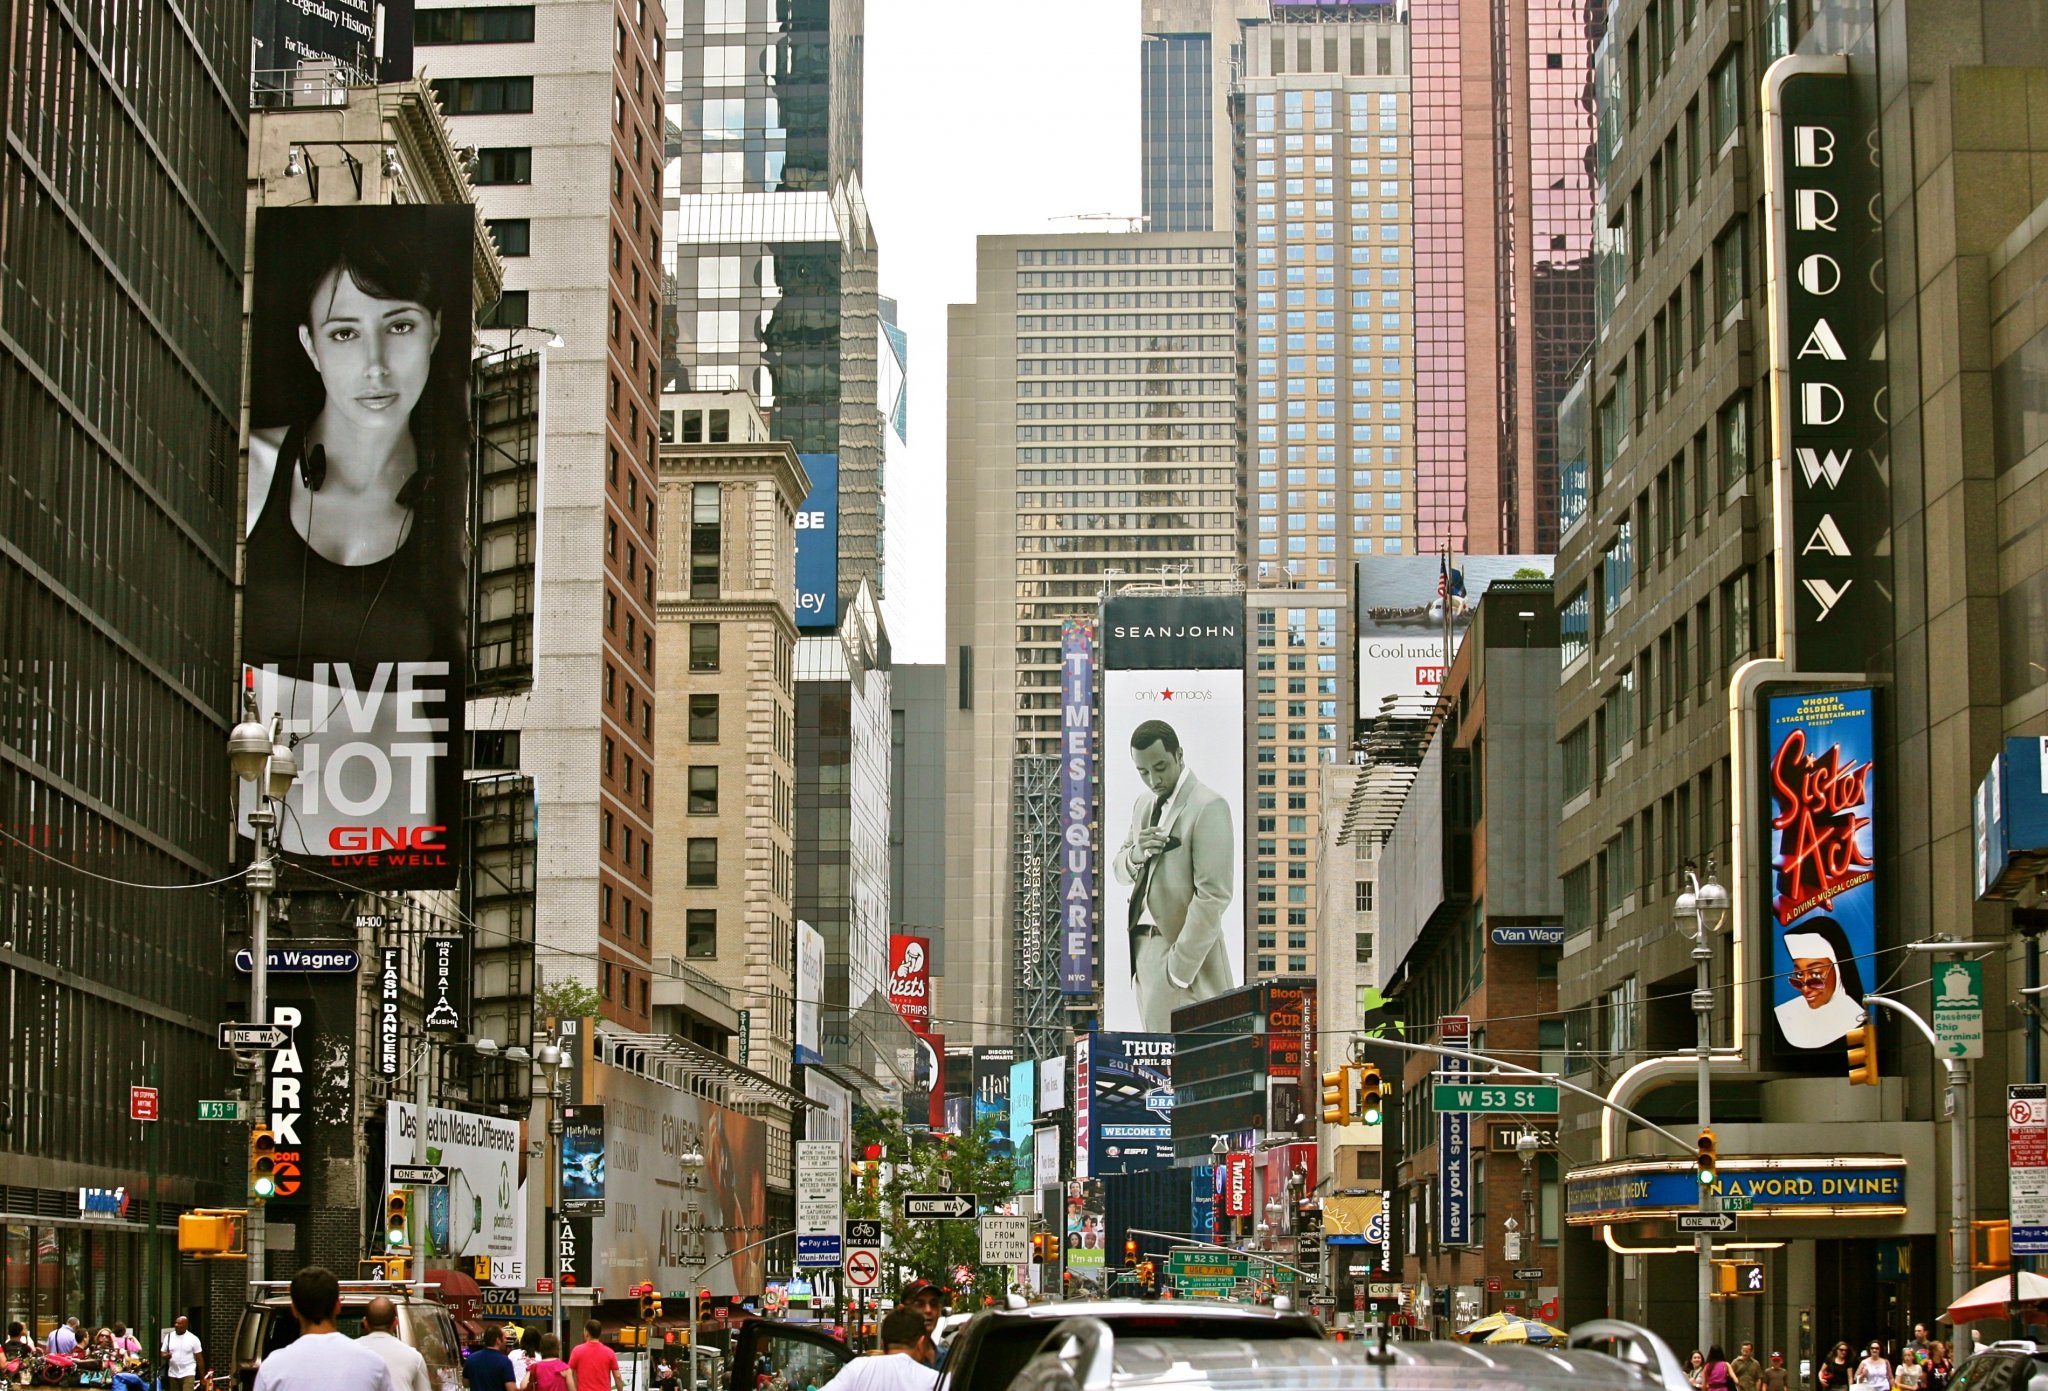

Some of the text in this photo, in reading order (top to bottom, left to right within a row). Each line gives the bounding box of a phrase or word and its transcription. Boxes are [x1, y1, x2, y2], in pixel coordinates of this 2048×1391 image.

[1794, 125, 1853, 622] BROADWAY
[1369, 643, 1442, 658] Cool unde
[262, 661, 449, 733] LIVE
[1135, 688, 1159, 702] only
[1803, 696, 1838, 706] WHOOPI
[1796, 704, 1845, 714] GOLDBERG
[1781, 715, 1804, 723] STAGE
[1806, 709, 1866, 721] ENTERTAINMENT
[1772, 728, 1873, 830] Sister
[328, 826, 447, 851] GNC
[1783, 805, 1874, 900] Act
[331, 855, 447, 866] LIVE WELL
[1786, 872, 1870, 922] A DIVINE MUSICAL COMEDY
[1023, 833, 1032, 990] AMERICAN EAGLE
[1032, 856, 1041, 964] OUTFITTERS
[356, 917, 383, 927] M-100
[1500, 930, 1525, 941] Van
[284, 951, 352, 968] Wagner
[438, 948, 449, 1005] ROBATA
[1068, 974, 1086, 982] NYC
[383, 950, 398, 1074] FLASH DANCERS
[901, 1004, 928, 1015] STRIPS
[430, 1018, 455, 1026] SUSHI
[1269, 1012, 1301, 1026] CUR
[1935, 1013, 1980, 1022] Passenger
[1935, 1023, 1959, 1032] Ship
[259, 1031, 281, 1042] WAY
[1936, 1033, 1981, 1041] Terminal
[271, 1006, 303, 1145] PARK
[1457, 1091, 1536, 1107] W 53 St
[201, 1104, 209, 1117] W
[212, 1103, 223, 1118] 53
[400, 1106, 515, 1153] Desed to Make a Difference
[1105, 1127, 1156, 1136] WELCOME
[398, 1170, 440, 1180] ONE WAY
[1448, 1163, 1463, 1198] york
[1232, 1158, 1247, 1211] Twizzlers
[1728, 1178, 1898, 1197] A WORD, DIVINE!
[914, 1201, 965, 1212] ONE WAY
[1723, 1198, 1743, 1210] W 53
[984, 1221, 1025, 1230] LEFT TURN
[1450, 1209, 1461, 1238] new
[1685, 1218, 1727, 1226] ONE WAY
[994, 1231, 1015, 1239] FROM
[1381, 1190, 1391, 1272] McDonald's
[808, 1240, 821, 1248] Pay
[984, 1240, 1025, 1249] LEFT TURN
[986, 1251, 1024, 1260] BAY ONLY
[1184, 1255, 1219, 1263] W 52 St
[481, 1290, 516, 1303] 1674
[481, 1305, 517, 1316] NTAL
